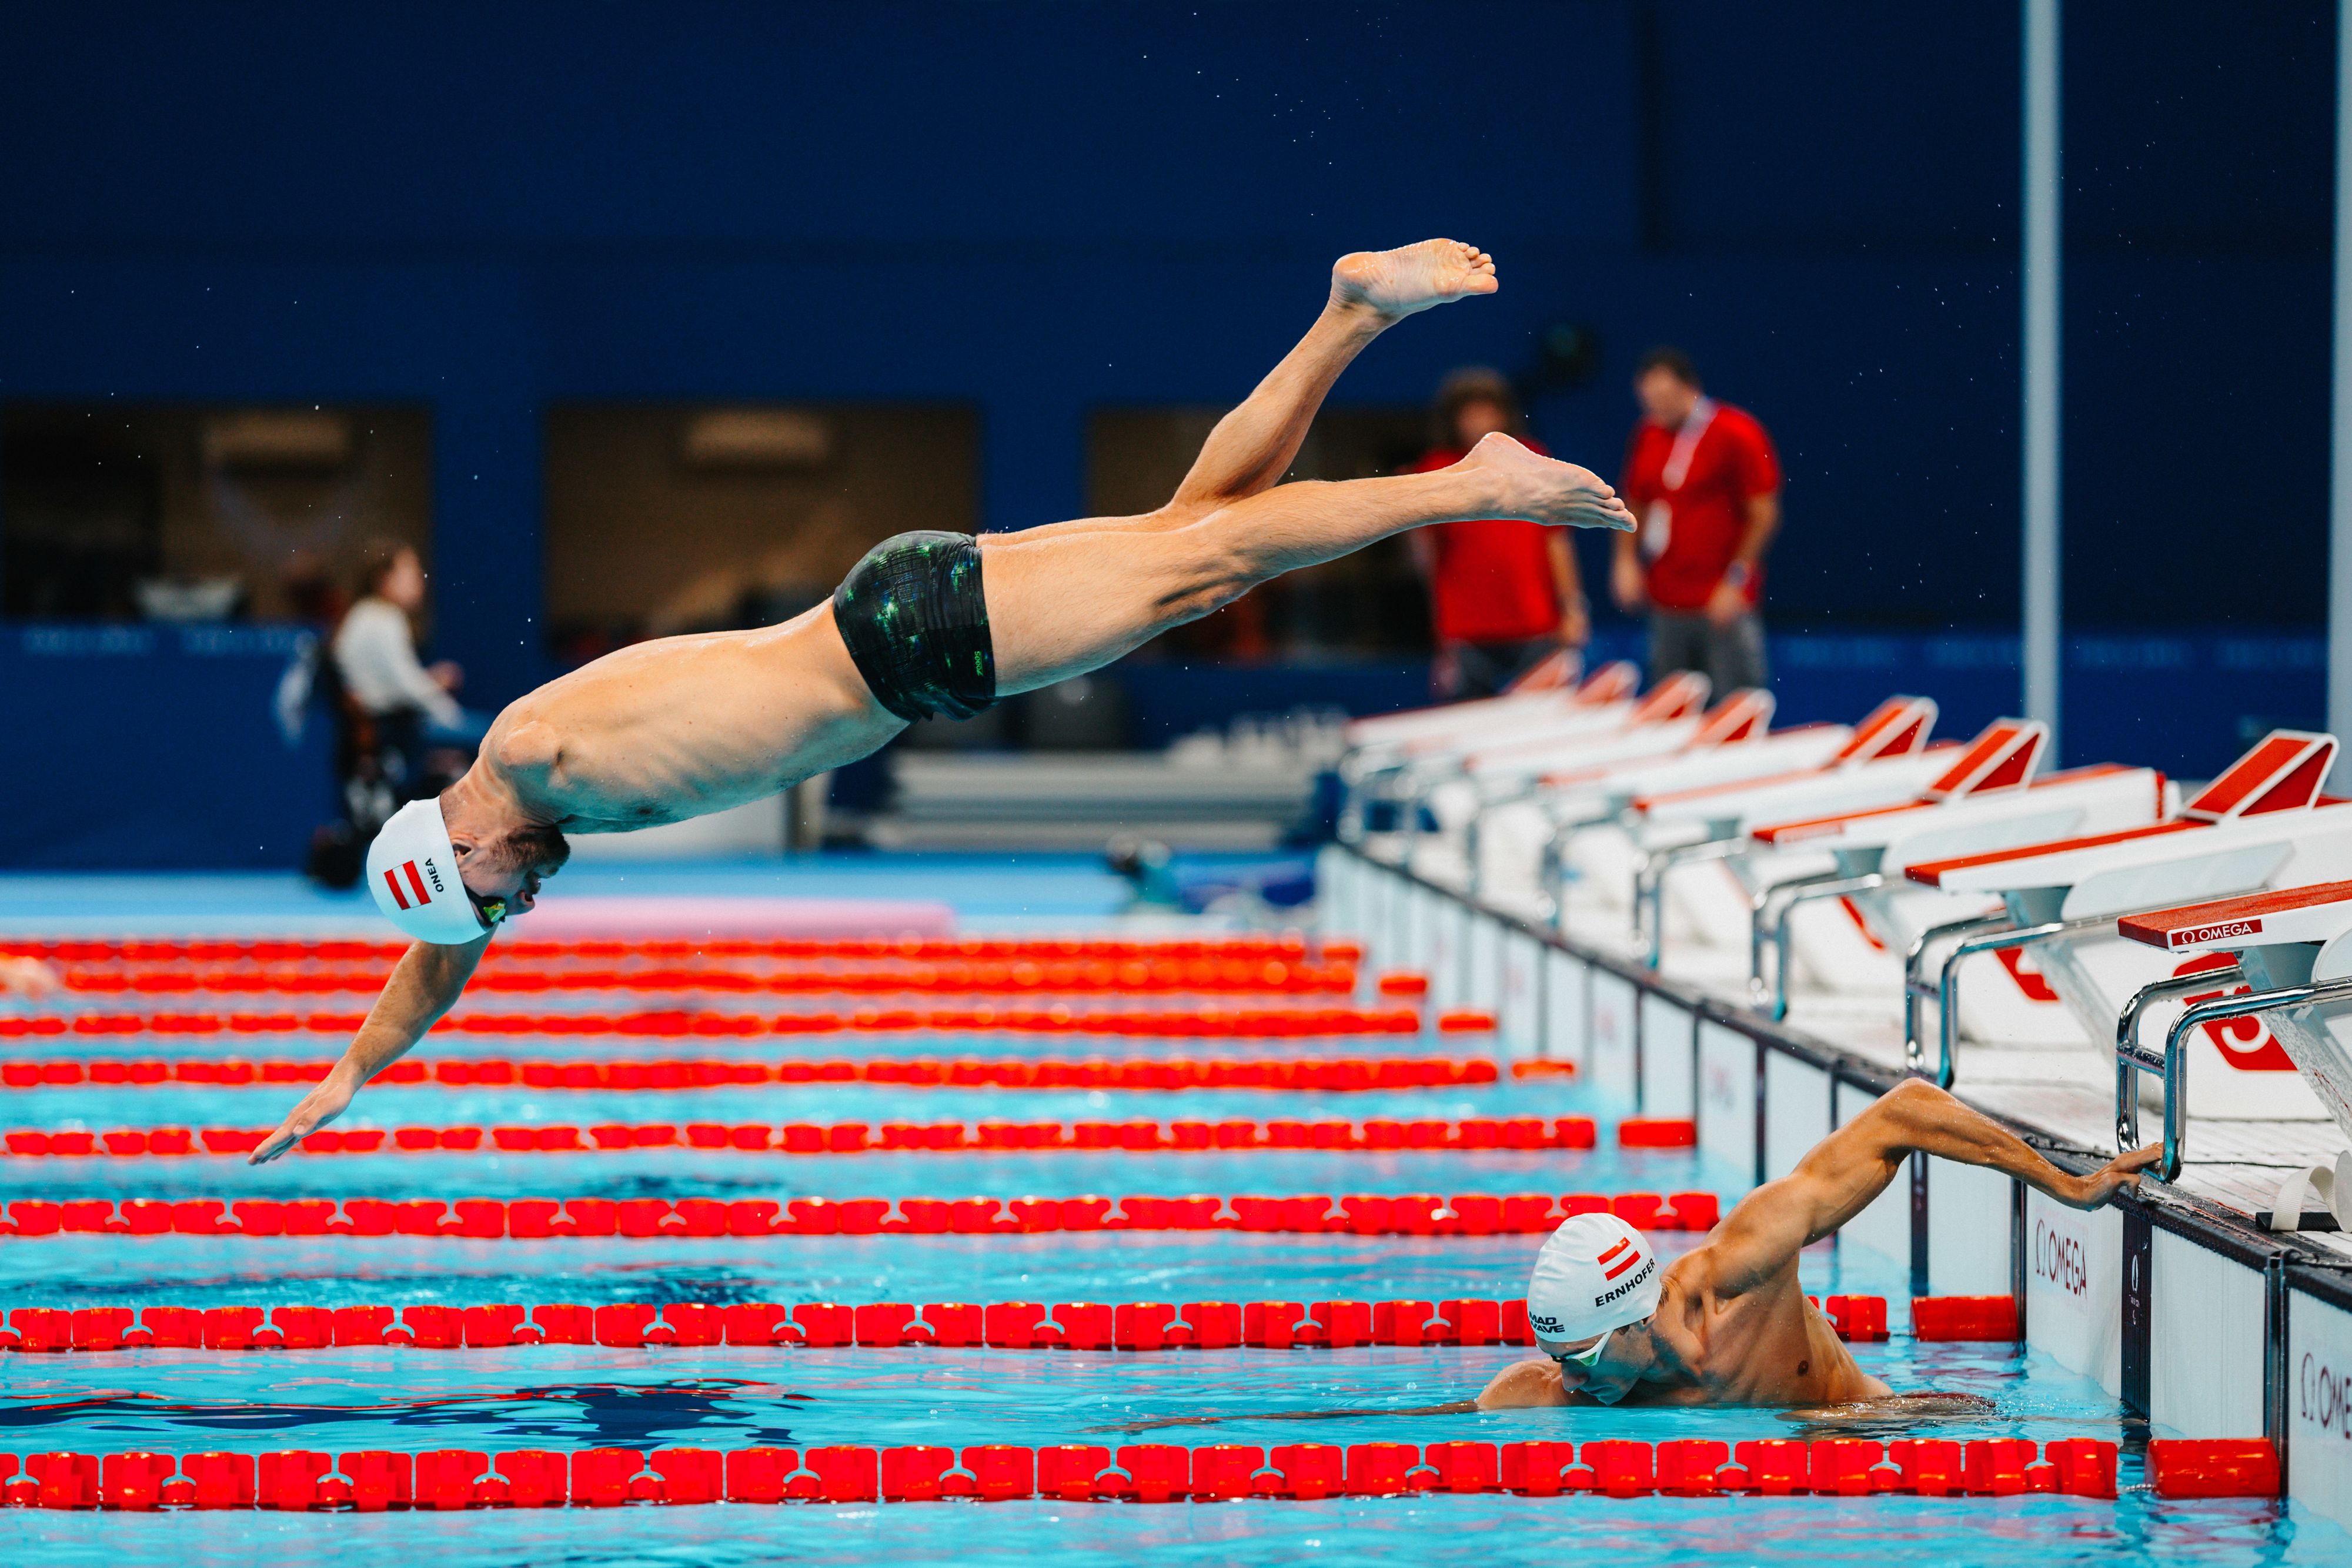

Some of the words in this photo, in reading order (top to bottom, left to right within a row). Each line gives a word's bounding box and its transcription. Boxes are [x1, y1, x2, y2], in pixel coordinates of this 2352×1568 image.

[425, 858, 444, 892] ONEA
[2199, 922, 2253, 941] OMEGA
[2049, 1229, 2087, 1299] OMEGA
[1595, 1258, 1655, 1308] ERNHOFER
[1529, 1310, 1557, 1325] MAD
